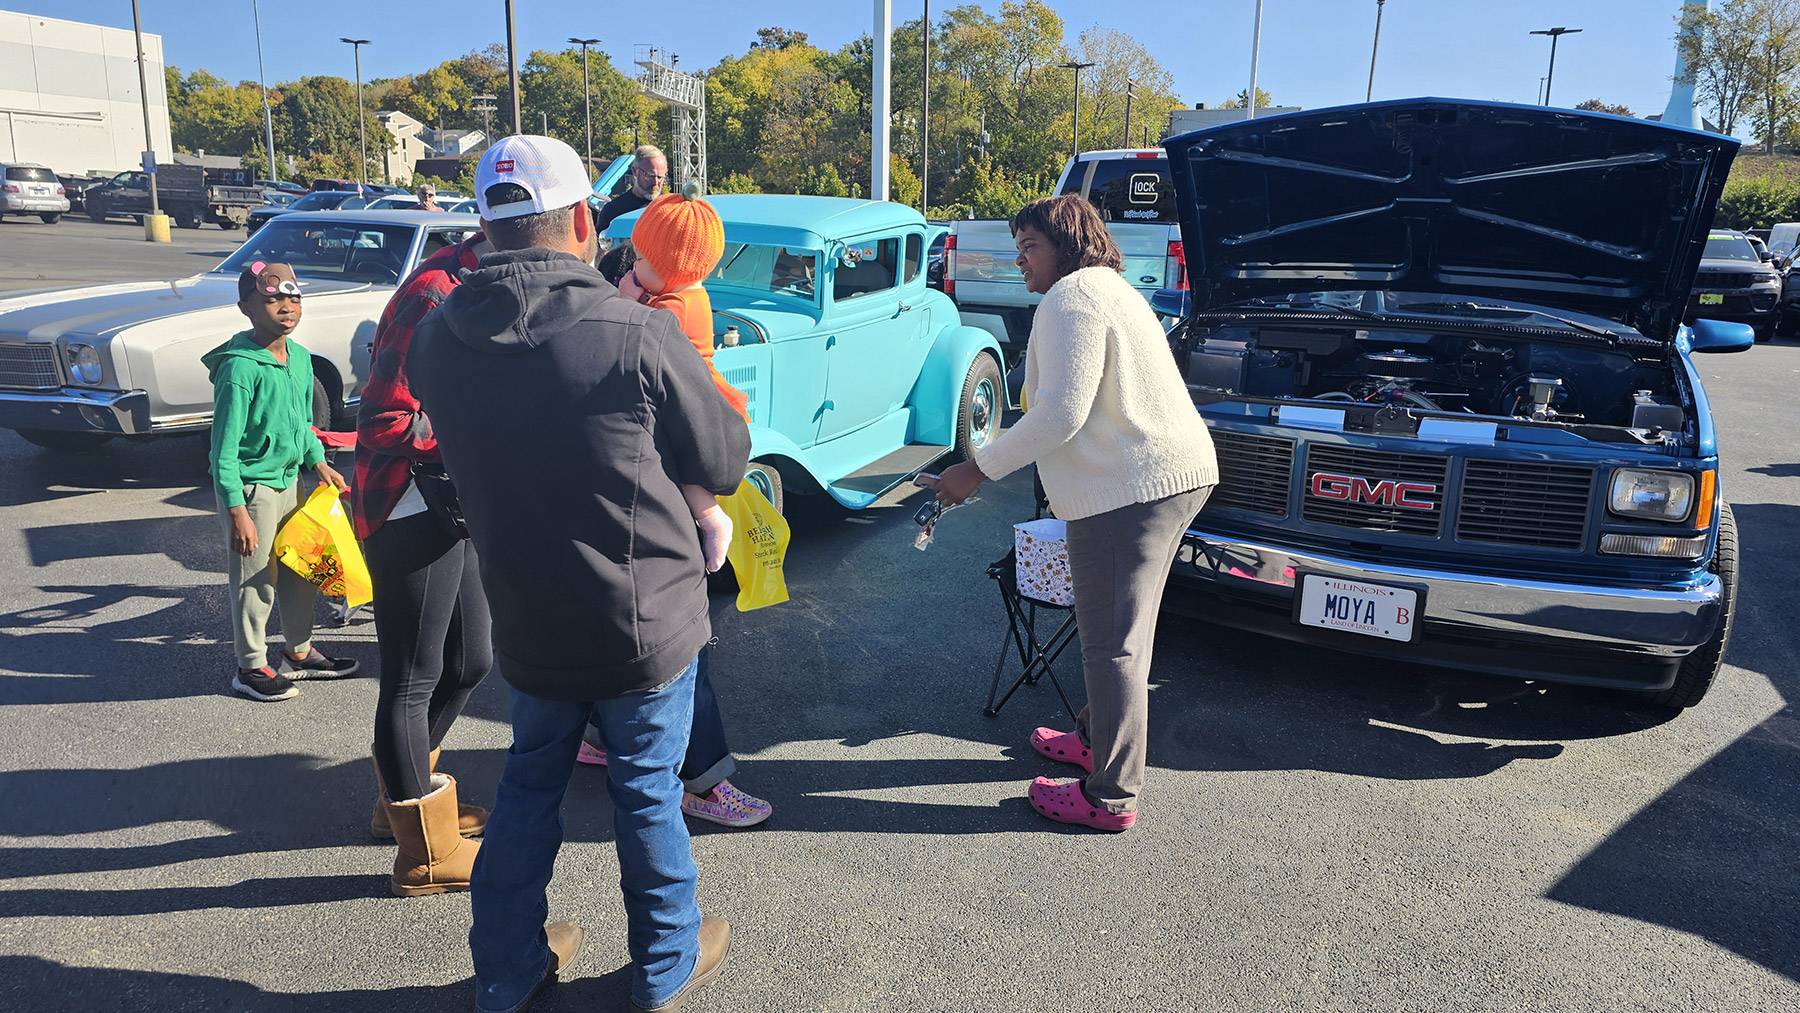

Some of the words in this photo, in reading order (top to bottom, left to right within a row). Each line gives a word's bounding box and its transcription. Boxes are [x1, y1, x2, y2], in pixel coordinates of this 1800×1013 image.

[1312, 472, 1436, 510] GMC
[1333, 582, 1386, 596] ILLINOIS
[1324, 593, 1375, 626] MOYA
[1395, 607, 1410, 625] B
